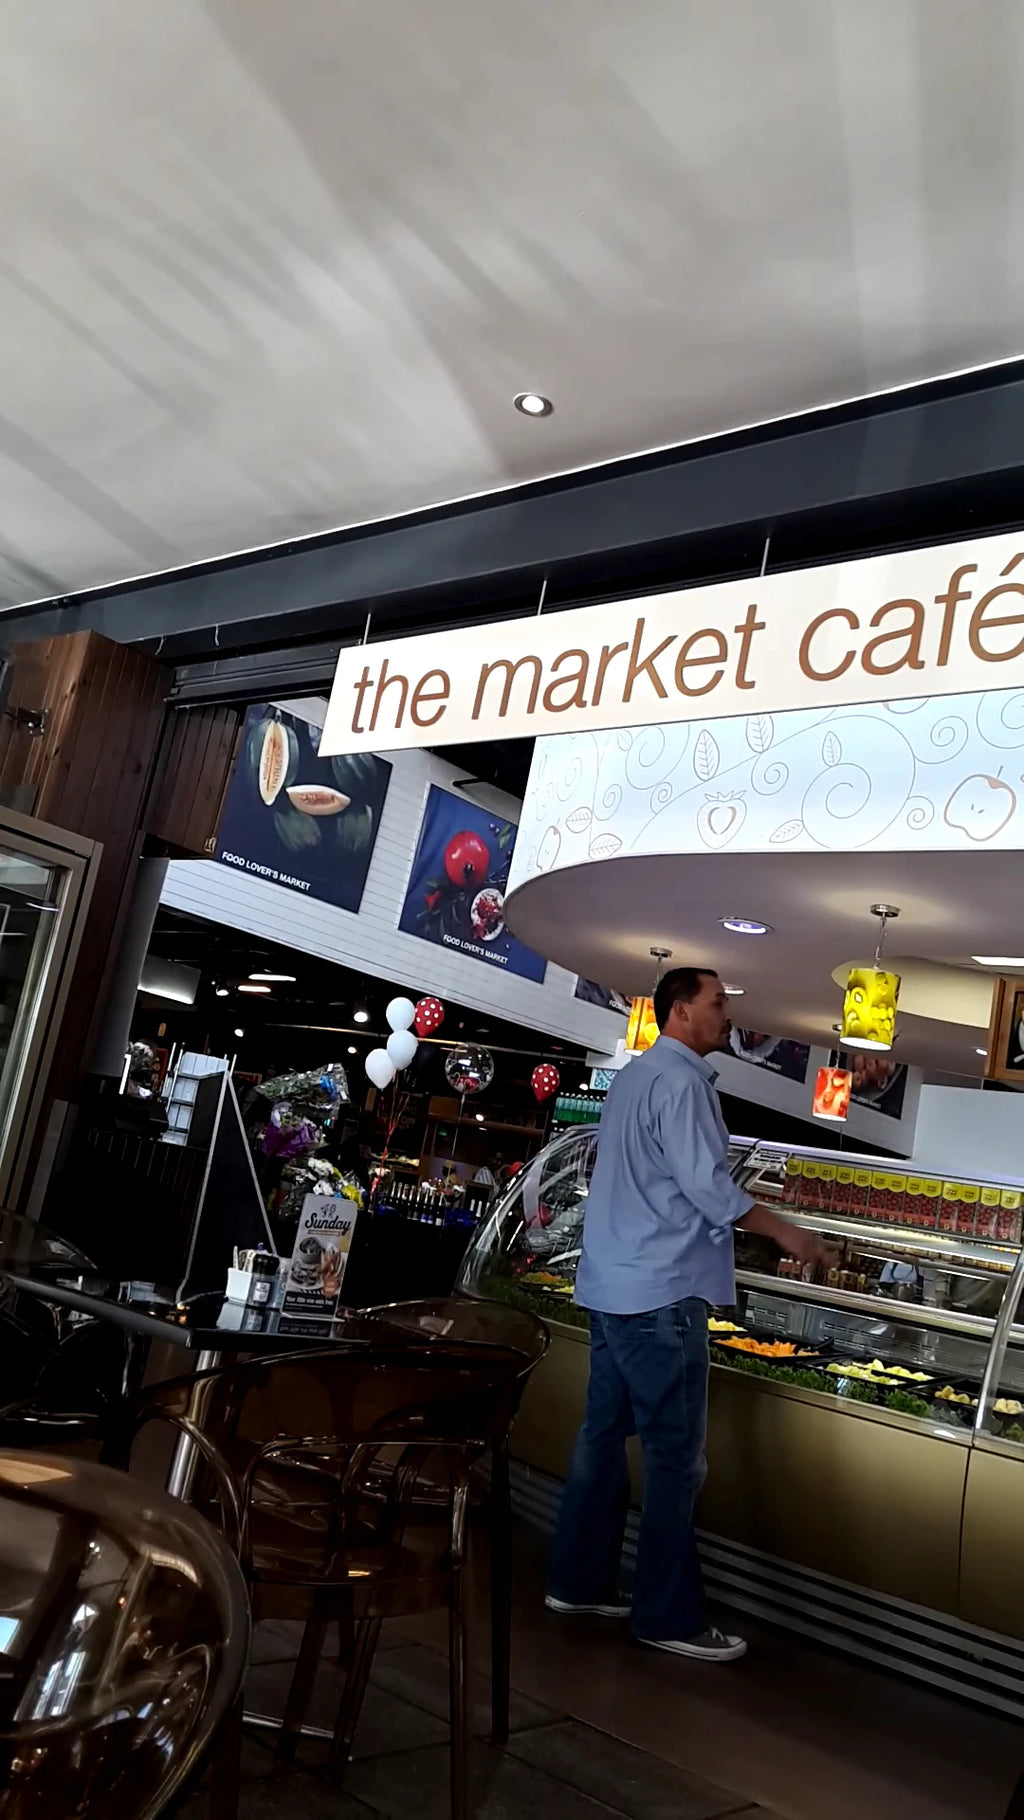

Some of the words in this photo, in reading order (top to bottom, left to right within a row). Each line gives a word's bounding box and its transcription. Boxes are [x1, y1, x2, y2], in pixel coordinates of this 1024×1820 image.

[351, 659, 451, 734] the
[471, 604, 766, 721] market
[798, 552, 1024, 683] café
[221, 851, 246, 867] FOOD
[246, 860, 279, 880] LOVER'S
[279, 873, 311, 891] MARKET
[443, 934, 461, 946] FOOD
[485, 950, 509, 964] MARKET
[305, 1212, 351, 1236] Sunday
